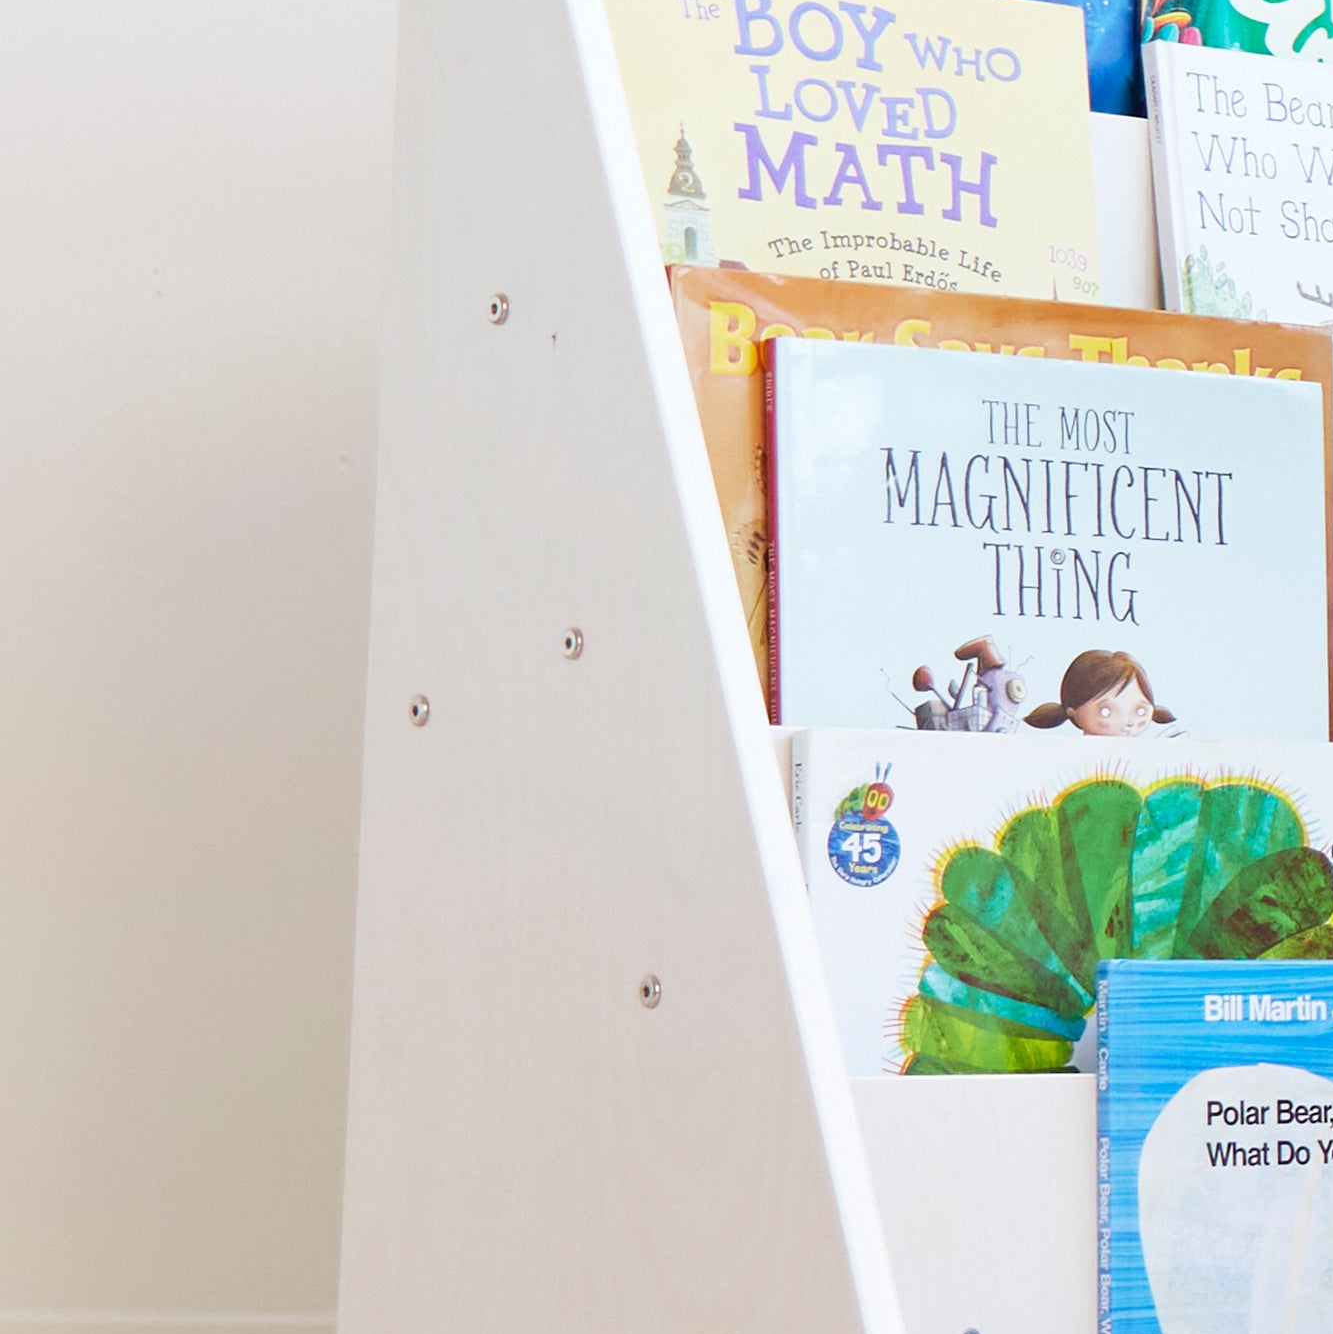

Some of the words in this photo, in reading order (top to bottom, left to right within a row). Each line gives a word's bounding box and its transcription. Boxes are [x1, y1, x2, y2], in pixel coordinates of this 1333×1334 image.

[904, 33, 1022, 83] WHO
[749, 64, 957, 141] LOVED
[1186, 72, 1248, 118] The
[733, 123, 998, 229] MATH
[1191, 130, 1278, 180] Who
[1197, 190, 1261, 235] Not
[768, 237, 814, 259] The
[819, 230, 950, 261] Improbable
[958, 250, 1003, 283] Life
[819, 261, 840, 280] of
[848, 260, 894, 279] Paul
[1049, 244, 1087, 273] 1039
[982, 400, 1042, 448] THE
[1059, 406, 1135, 455] MOST
[880, 447, 1233, 546] MAGNIFICENT
[841, 832, 882, 863] 45
[1098, 979, 1109, 1032] Martin
[1204, 994, 1243, 1022] Bill
[1250, 994, 1327, 1022] Martin
[1099, 1048, 1109, 1091] Carle
[1206, 1100, 1270, 1126] Polar
[1099, 1137, 1110, 1181] Polar
[1206, 1142, 1270, 1167] What
[1277, 1140, 1311, 1166] Do
[1099, 1185, 1110, 1224] Bear,
[1100, 1228, 1111, 1270] Polar
